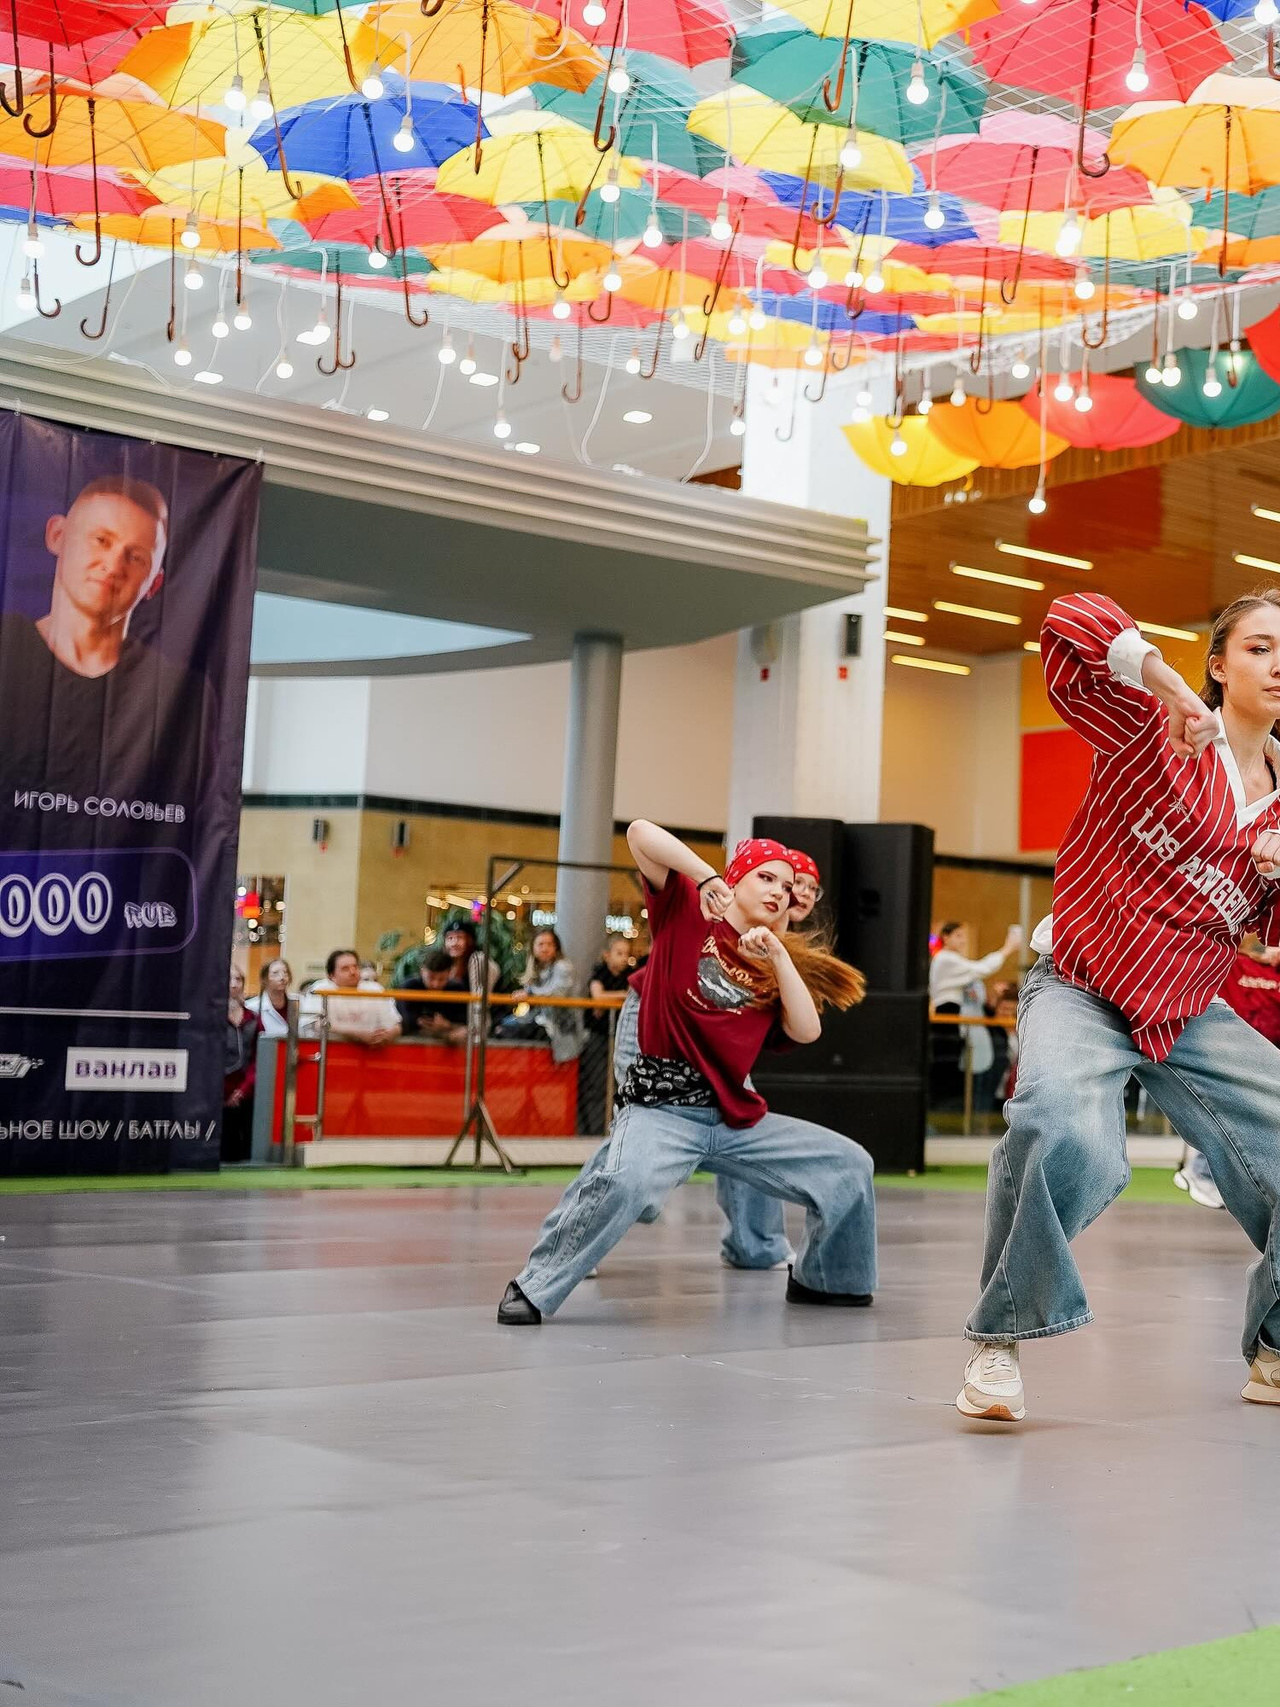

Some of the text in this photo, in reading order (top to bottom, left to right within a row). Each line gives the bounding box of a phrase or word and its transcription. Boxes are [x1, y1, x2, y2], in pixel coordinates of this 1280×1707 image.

[14, 789, 187, 824] ИГОРЬ СОЛОВЬЕВ
[1131, 807, 1180, 861] LOS
[124, 901, 178, 929] RUB
[75, 1060, 178, 1080] ванлав
[58, 1119, 110, 1140] ШОУ
[128, 1119, 201, 1140] БАТТЛЫ
